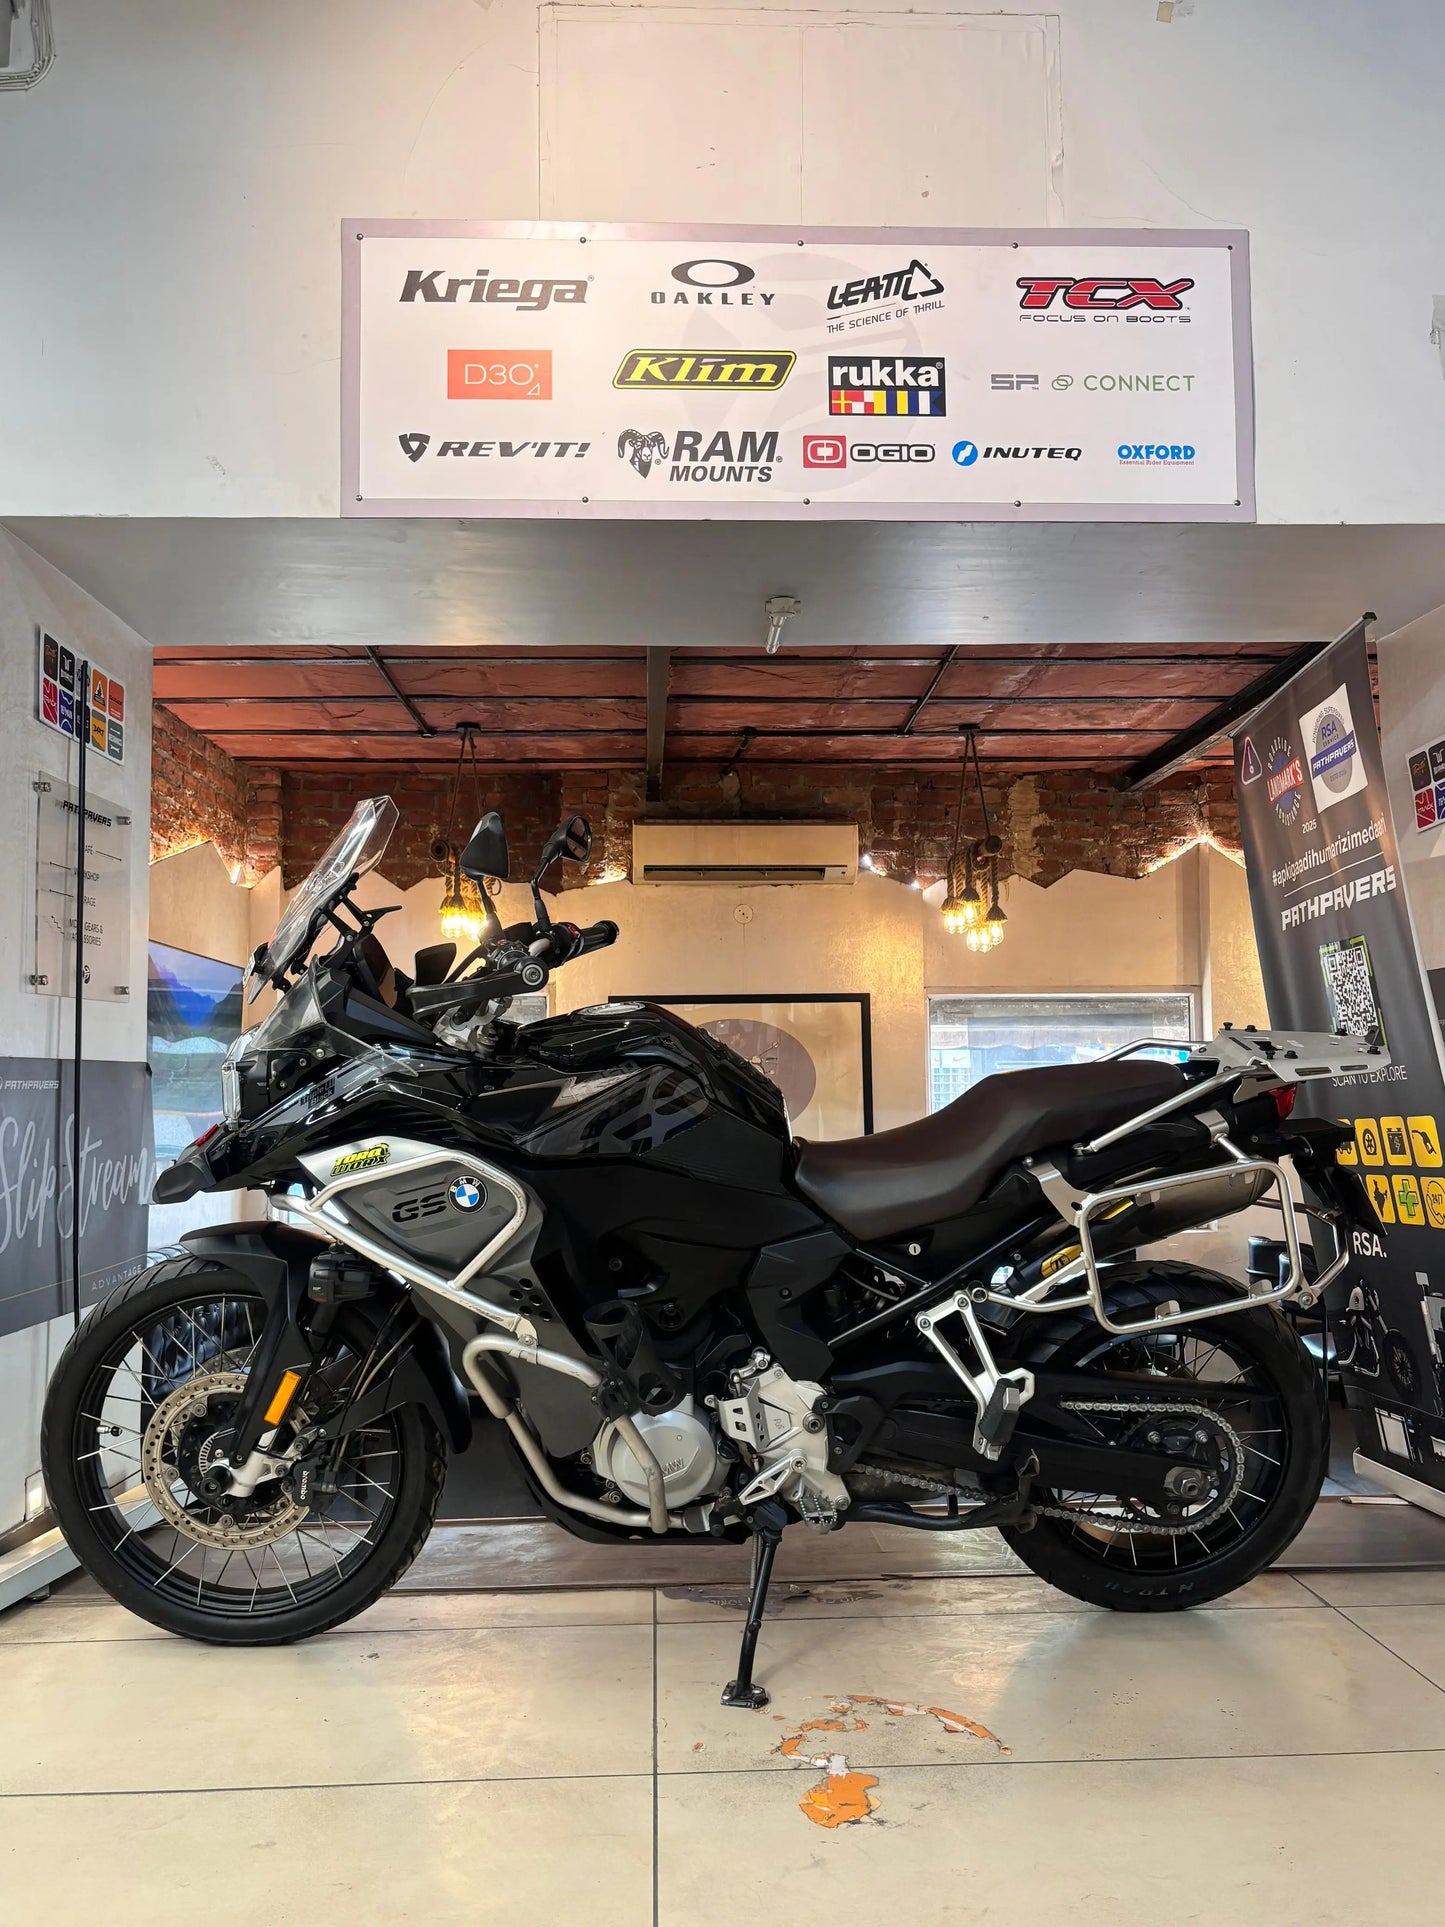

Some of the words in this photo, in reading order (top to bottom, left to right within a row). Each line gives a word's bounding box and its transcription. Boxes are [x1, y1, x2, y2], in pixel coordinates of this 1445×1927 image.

[399, 269, 588, 311] Kriega
[651, 291, 775, 306] OAKLEY
[1016, 277, 1195, 310] TCX
[827, 322, 845, 333] THE
[849, 312, 891, 329] SCIENCE
[895, 308, 909, 318] OF
[913, 300, 945, 314] THRILL
[1019, 315, 1086, 323] FOCUS
[1126, 315, 1191, 323] BOOTS
[624, 356, 779, 384] Klim
[832, 359, 940, 387] rukka
[990, 374, 1039, 391] SP
[1083, 374, 1195, 392] CONNECT
[436, 441, 591, 458] REV'IT!
[672, 431, 779, 463] RAM
[850, 443, 936, 462] OGIO
[983, 447, 1082, 461] INUTEQ
[1117, 444, 1196, 460] OXFORD
[669, 465, 772, 482] MOUNTS
[1321, 720, 1338, 740] RSA
[1313, 738, 1355, 773] PATHPAVERS
[63, 799, 112, 827] PATPAVERS
[1302, 818, 1317, 834] 2025
[1281, 865, 1396, 931] PATHPAVERS
[4, 1079, 60, 1090] PATHPAVERS
[1331, 1074, 1357, 1087] SCAN
[1369, 1064, 1408, 1083] EXPLORE
[391, 1191, 447, 1223] GS
[1353, 1231, 1388, 1259] RSA.
[91, 1264, 142, 1291] ADVANTAGE
[299, 1470, 311, 1500] brembo
